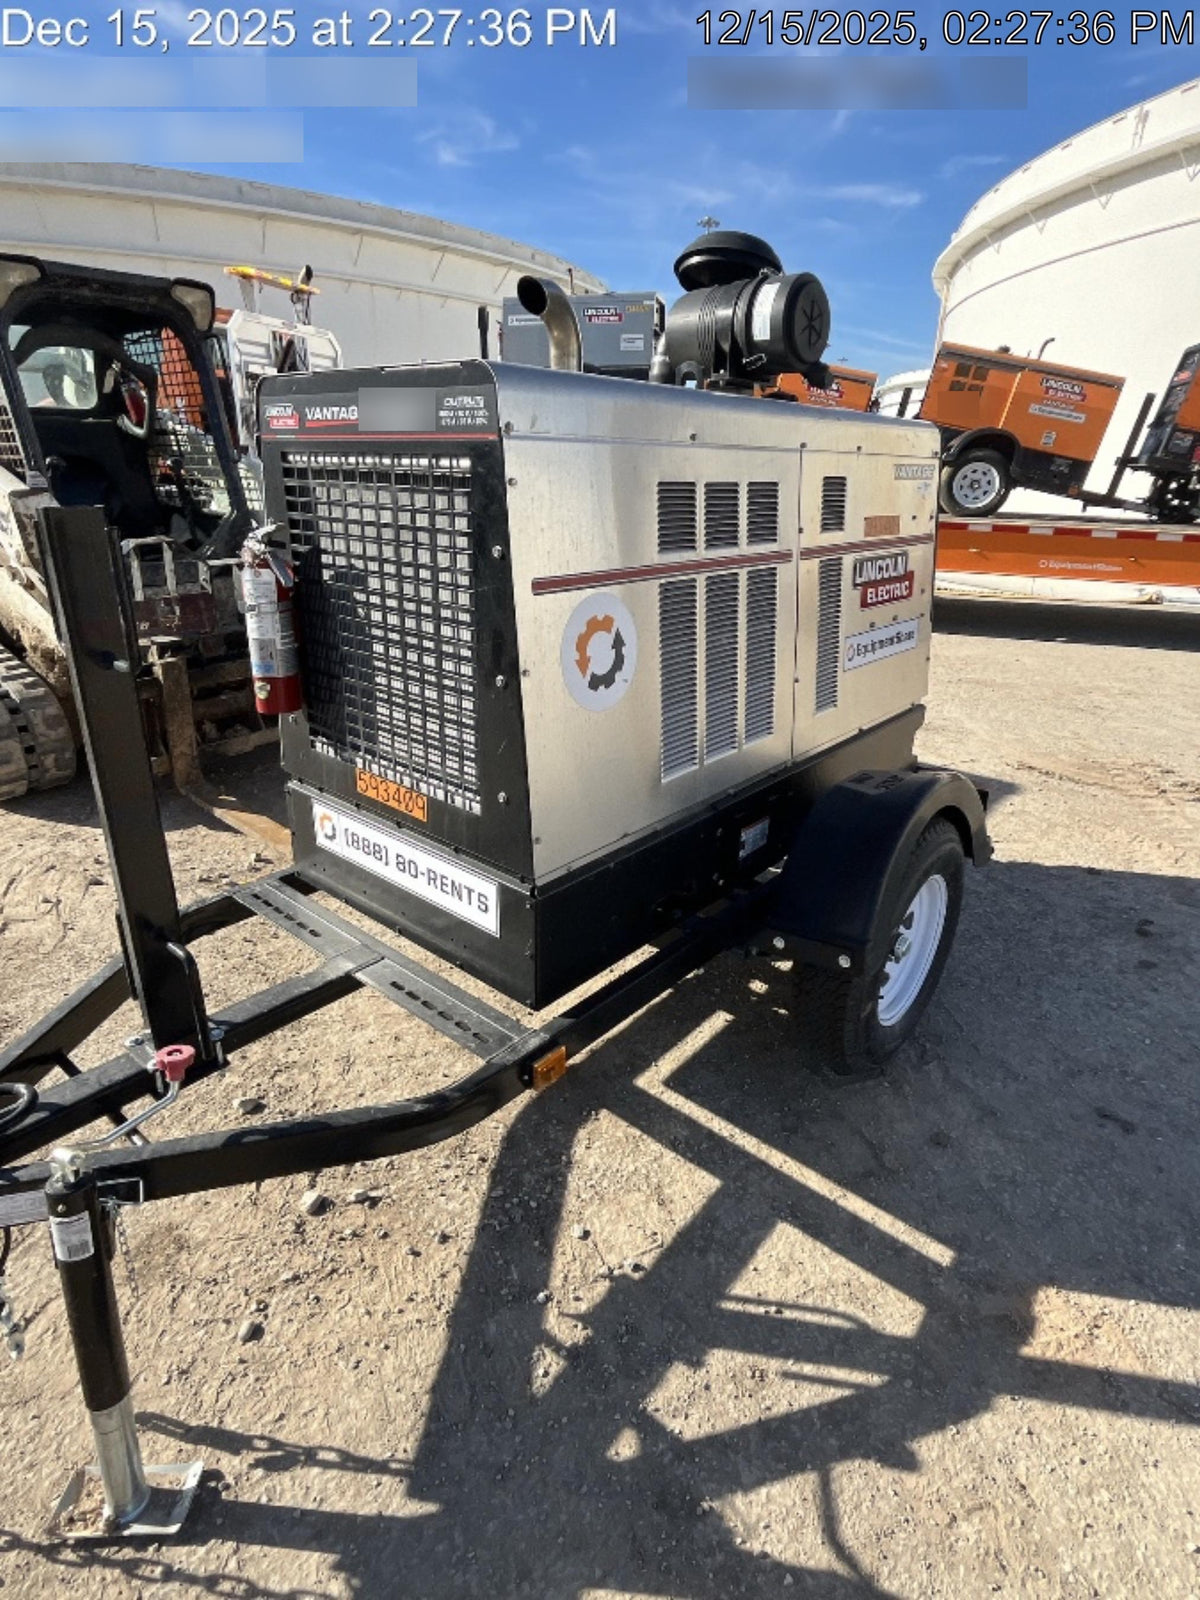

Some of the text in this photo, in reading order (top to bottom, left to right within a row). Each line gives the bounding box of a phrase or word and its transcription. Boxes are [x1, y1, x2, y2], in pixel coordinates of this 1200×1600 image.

[305, 405, 358, 421] VANTAG
[855, 555, 906, 584] LINCOLN
[867, 580, 909, 603] ELECTRIC
[358, 771, 426, 820] 593409
[344, 827, 489, 914] (888) 80-RENTS
